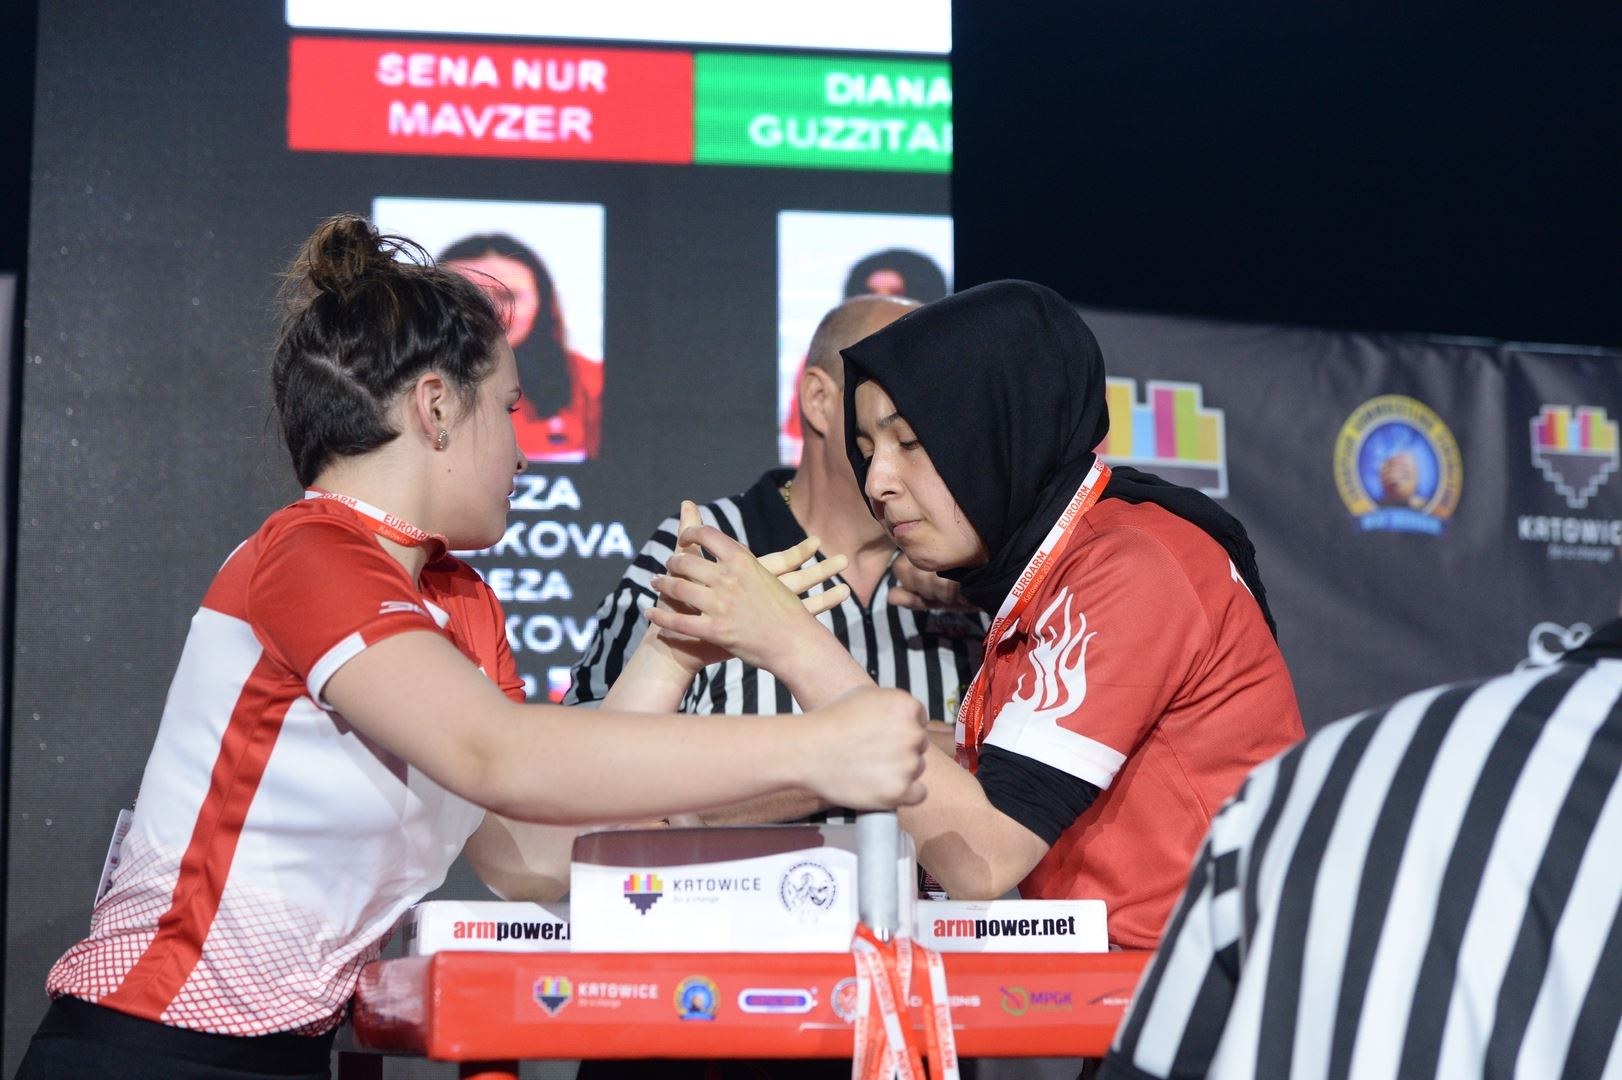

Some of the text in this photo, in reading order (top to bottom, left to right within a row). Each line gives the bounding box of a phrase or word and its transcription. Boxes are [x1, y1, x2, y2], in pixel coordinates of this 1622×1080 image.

[377, 52, 607, 93] SENA NUR
[824, 72, 952, 109] DIANA
[388, 100, 592, 142] MAVZER
[509, 474, 581, 510] ZA
[1058, 485, 1091, 530] EUROARM
[478, 521, 634, 559] KOVA
[477, 567, 572, 602] EZA
[1011, 550, 1048, 598] EUROARM
[1022, 557, 1055, 603] Katowice 2017
[673, 877, 761, 892] KATOWICE
[933, 916, 1076, 939] armpower.net
[578, 982, 658, 1000] KATOWICE
